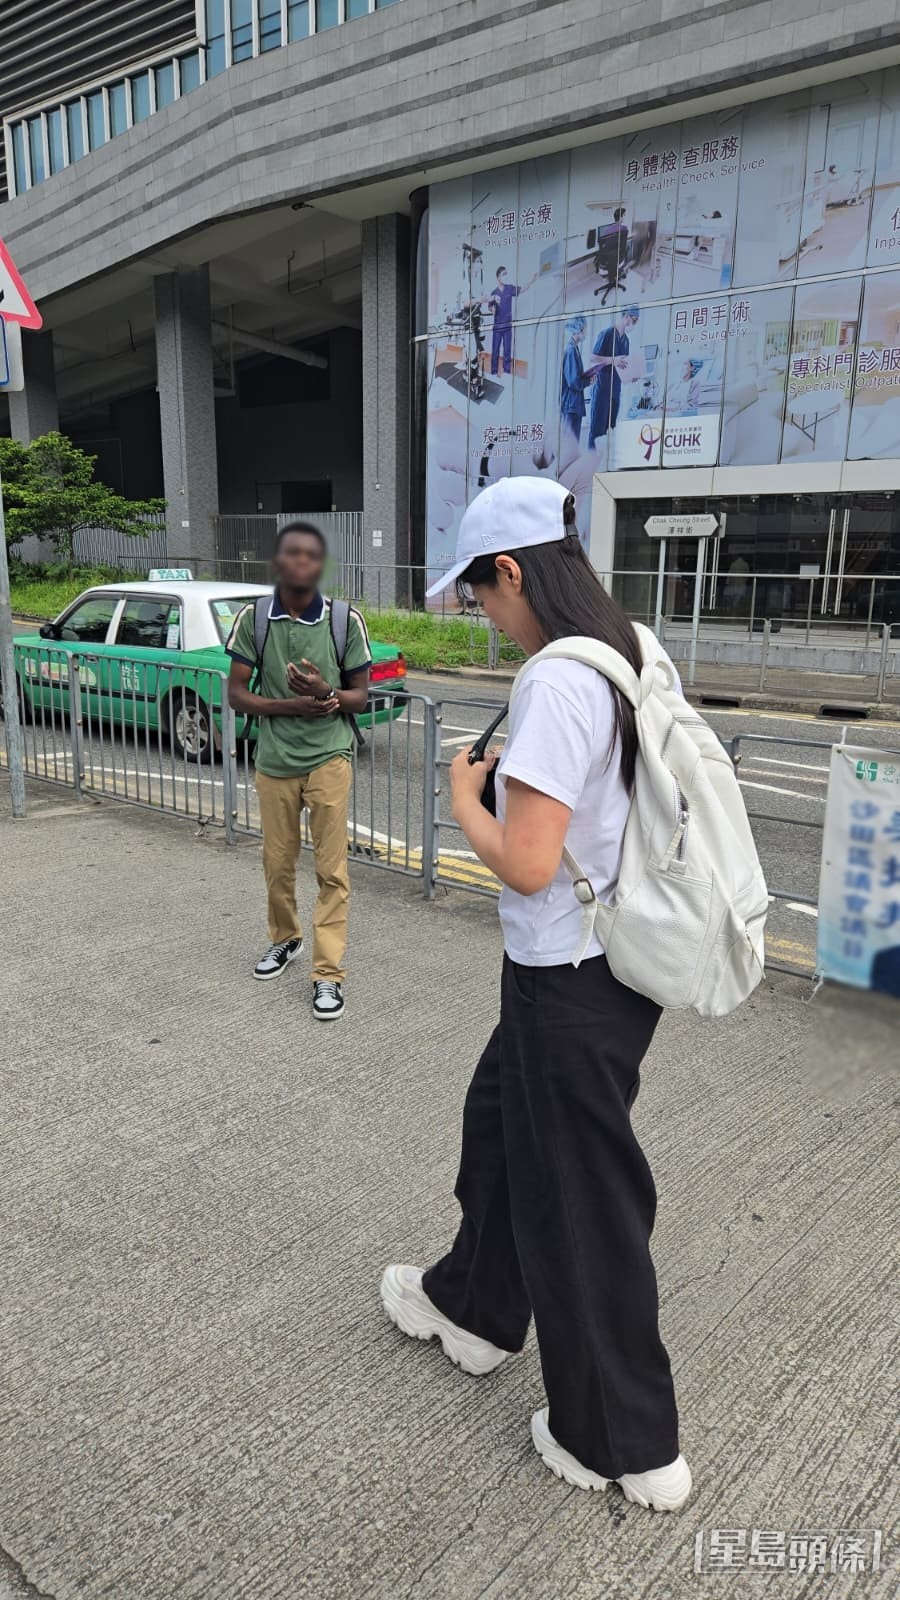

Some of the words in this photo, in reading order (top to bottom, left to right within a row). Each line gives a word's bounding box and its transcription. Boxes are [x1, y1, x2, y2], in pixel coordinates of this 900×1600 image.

[625, 136, 739, 182] 身體檢查服務
[642, 177, 677, 192] Health
[681, 169, 716, 185] Check
[720, 158, 765, 176] Service
[486, 203, 552, 235] 物理治療
[675, 301, 751, 329] 日間手術
[674, 333, 695, 344] Day
[701, 328, 748, 341] Surgery
[791, 348, 900, 379] 專科門診服
[789, 378, 850, 397] Specialist
[483, 424, 544, 443] 疫苗服務
[664, 433, 701, 448] CUHK
[158, 570, 189, 579] TAXI
